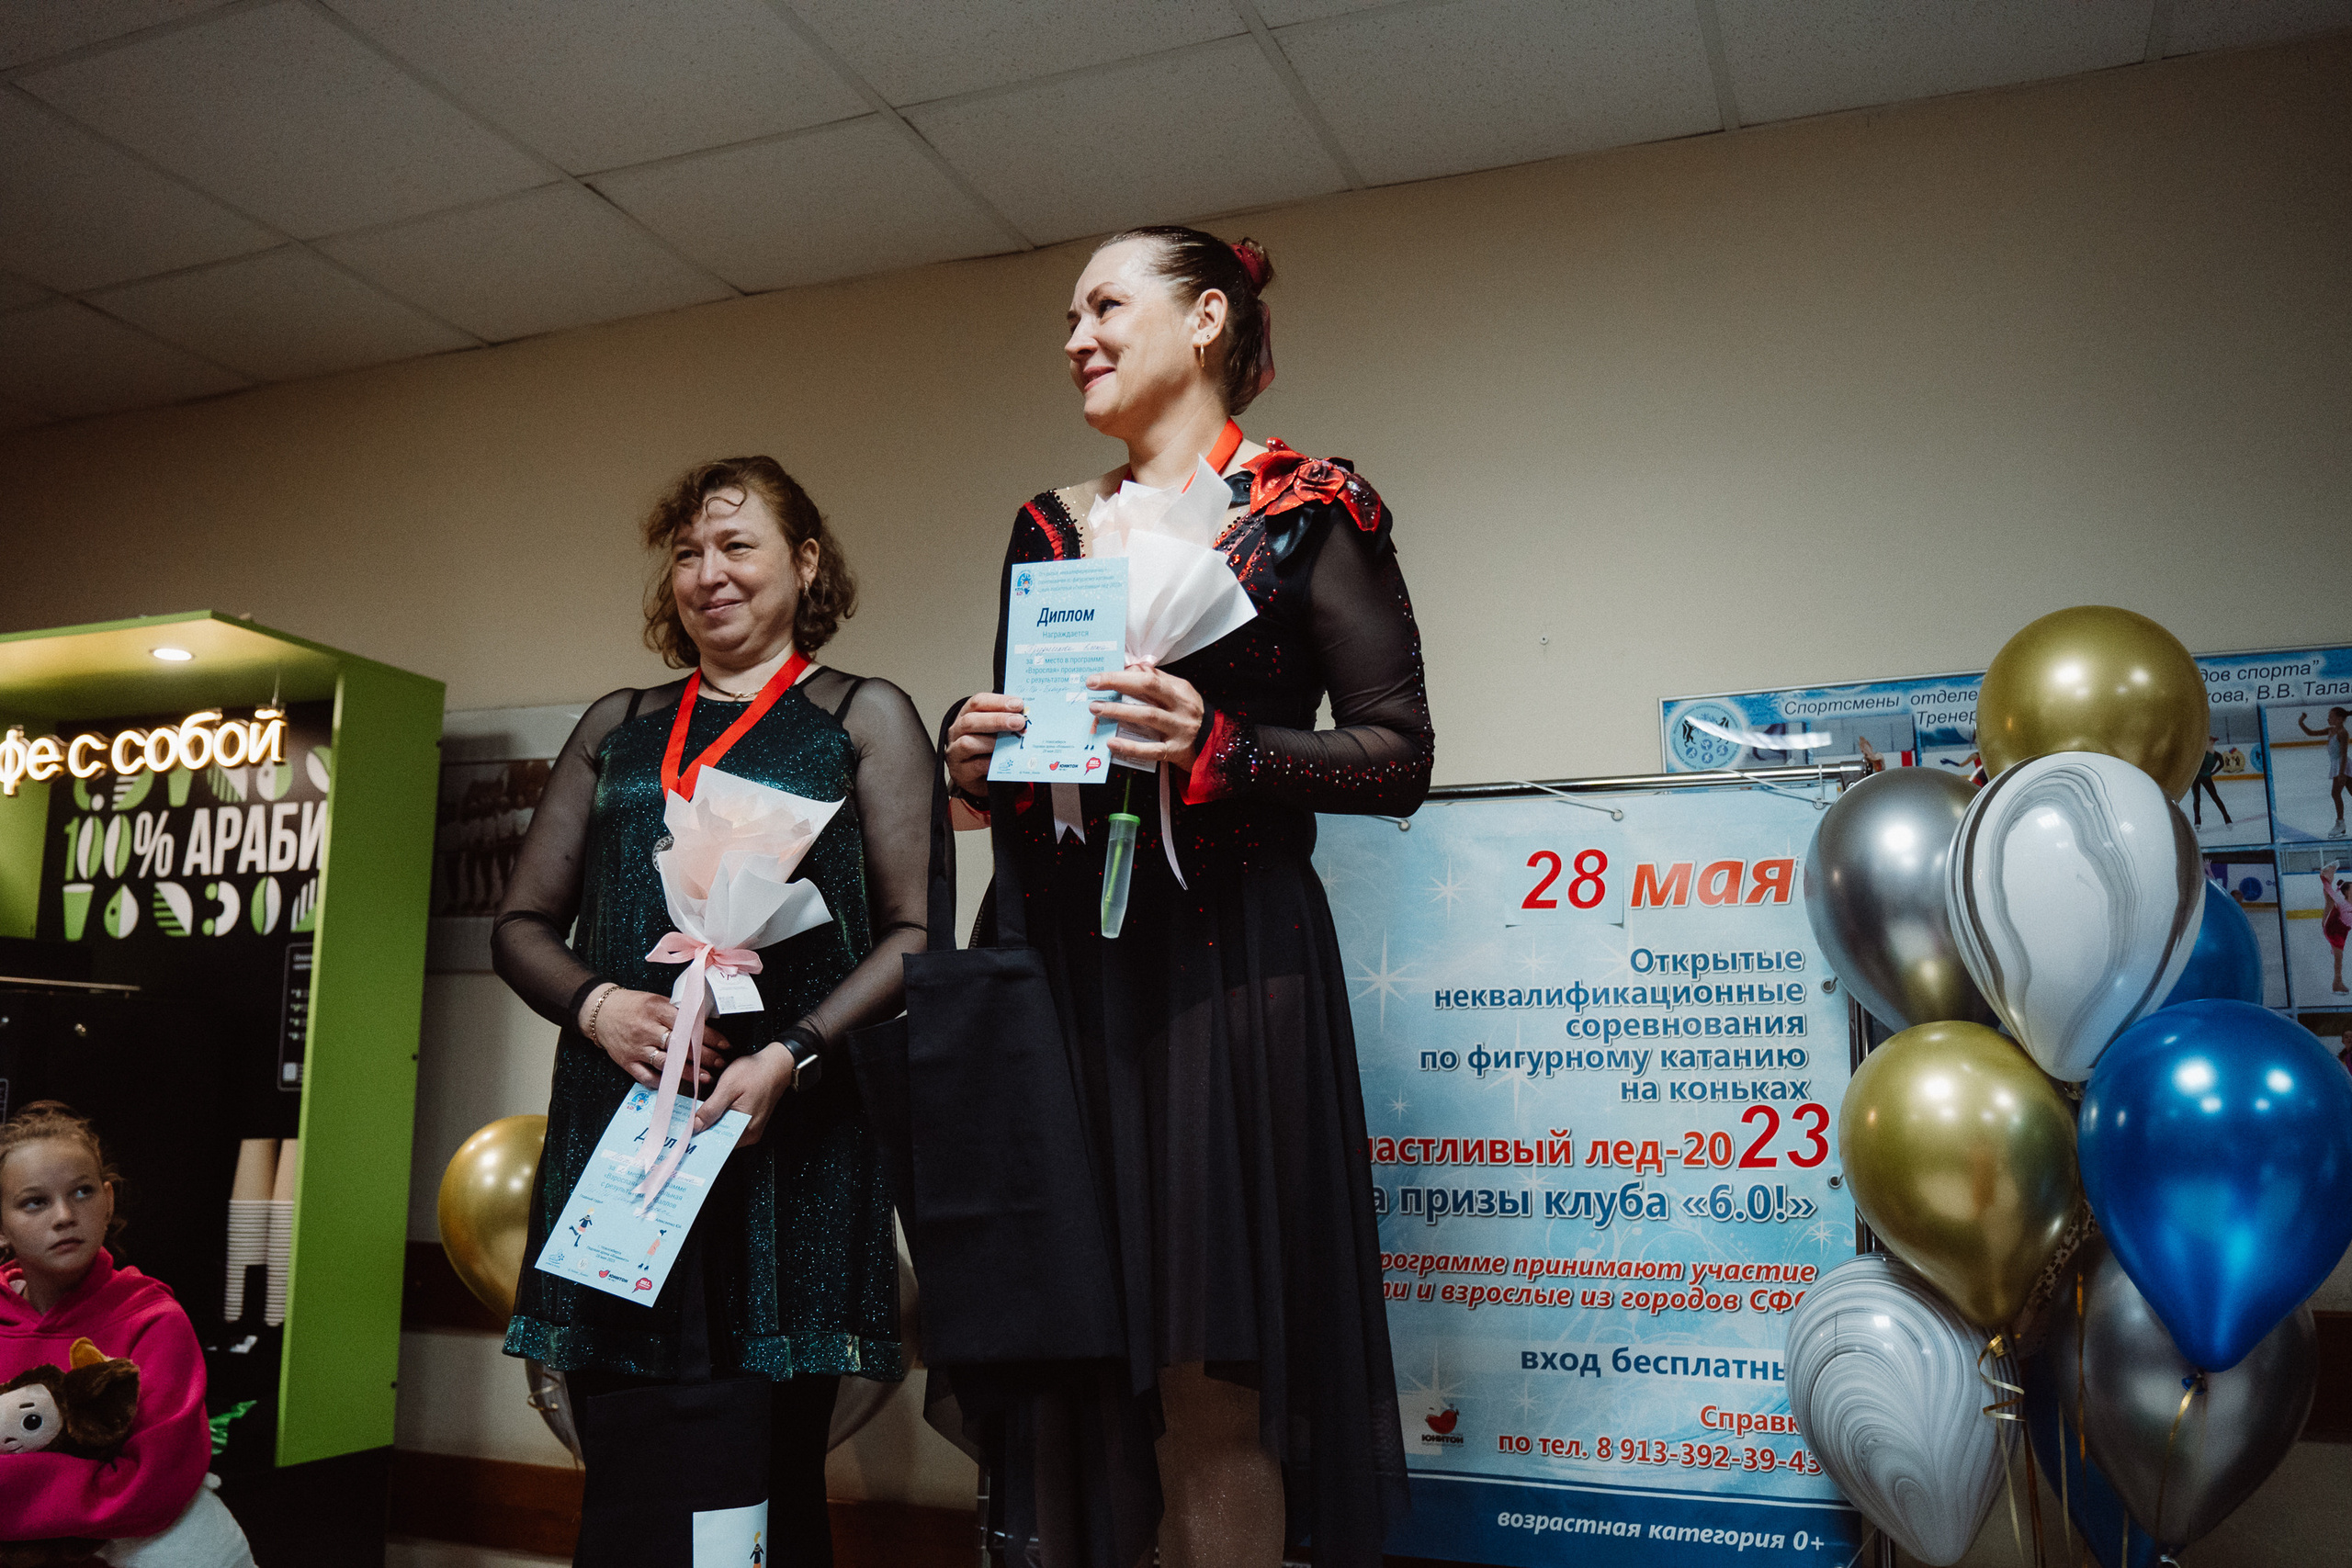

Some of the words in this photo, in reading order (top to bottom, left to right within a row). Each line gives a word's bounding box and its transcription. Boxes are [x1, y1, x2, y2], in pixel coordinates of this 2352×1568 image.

[1037, 607, 1094, 626] Диплом
[1043, 630, 1089, 638] Награждается
[1069, 656, 1104, 665] программе
[1031, 676, 1069, 684] результатом
[2207, 691, 2249, 704] ова,
[2257, 683, 2294, 700] В.В.
[2303, 681, 2352, 696] Тала
[1784, 694, 1900, 716] Спортсмены
[68, 734, 107, 779] с
[111, 707, 287, 775] собой
[63, 810, 175, 880] 100%
[1521, 849, 1608, 909] 28
[1630, 856, 1795, 908] мая
[1630, 948, 1804, 978] Открытые
[1434, 980, 1805, 1012] неквалификационные
[1566, 1014, 1806, 1045] соревнования
[1420, 1048, 1460, 1071] по
[1468, 1044, 1651, 1077] фигурному
[1660, 1045, 1808, 1069] катанию
[1621, 1077, 1660, 1101] на
[1669, 1077, 1811, 1102] коньках
[1399, 1185, 1532, 1224] призы
[1544, 1183, 1668, 1230] клуба
[1512, 1255, 1685, 1283] принимают
[1690, 1261, 1818, 1287] участие
[1417, 1282, 1434, 1302] и
[1441, 1282, 1574, 1310] взрослые
[1580, 1287, 1613, 1309] из
[1621, 1287, 1741, 1316] городов
[1521, 1348, 1601, 1378] вход
[1421, 1434, 1464, 1444] ЮНИТОН
[1498, 1434, 1532, 1455] по
[1538, 1437, 1589, 1460] тел.
[1596, 1437, 1613, 1461] 8
[1497, 1509, 1641, 1540] возрастная
[1648, 1523, 1785, 1551] категория
[1792, 1530, 1826, 1552] 0+
